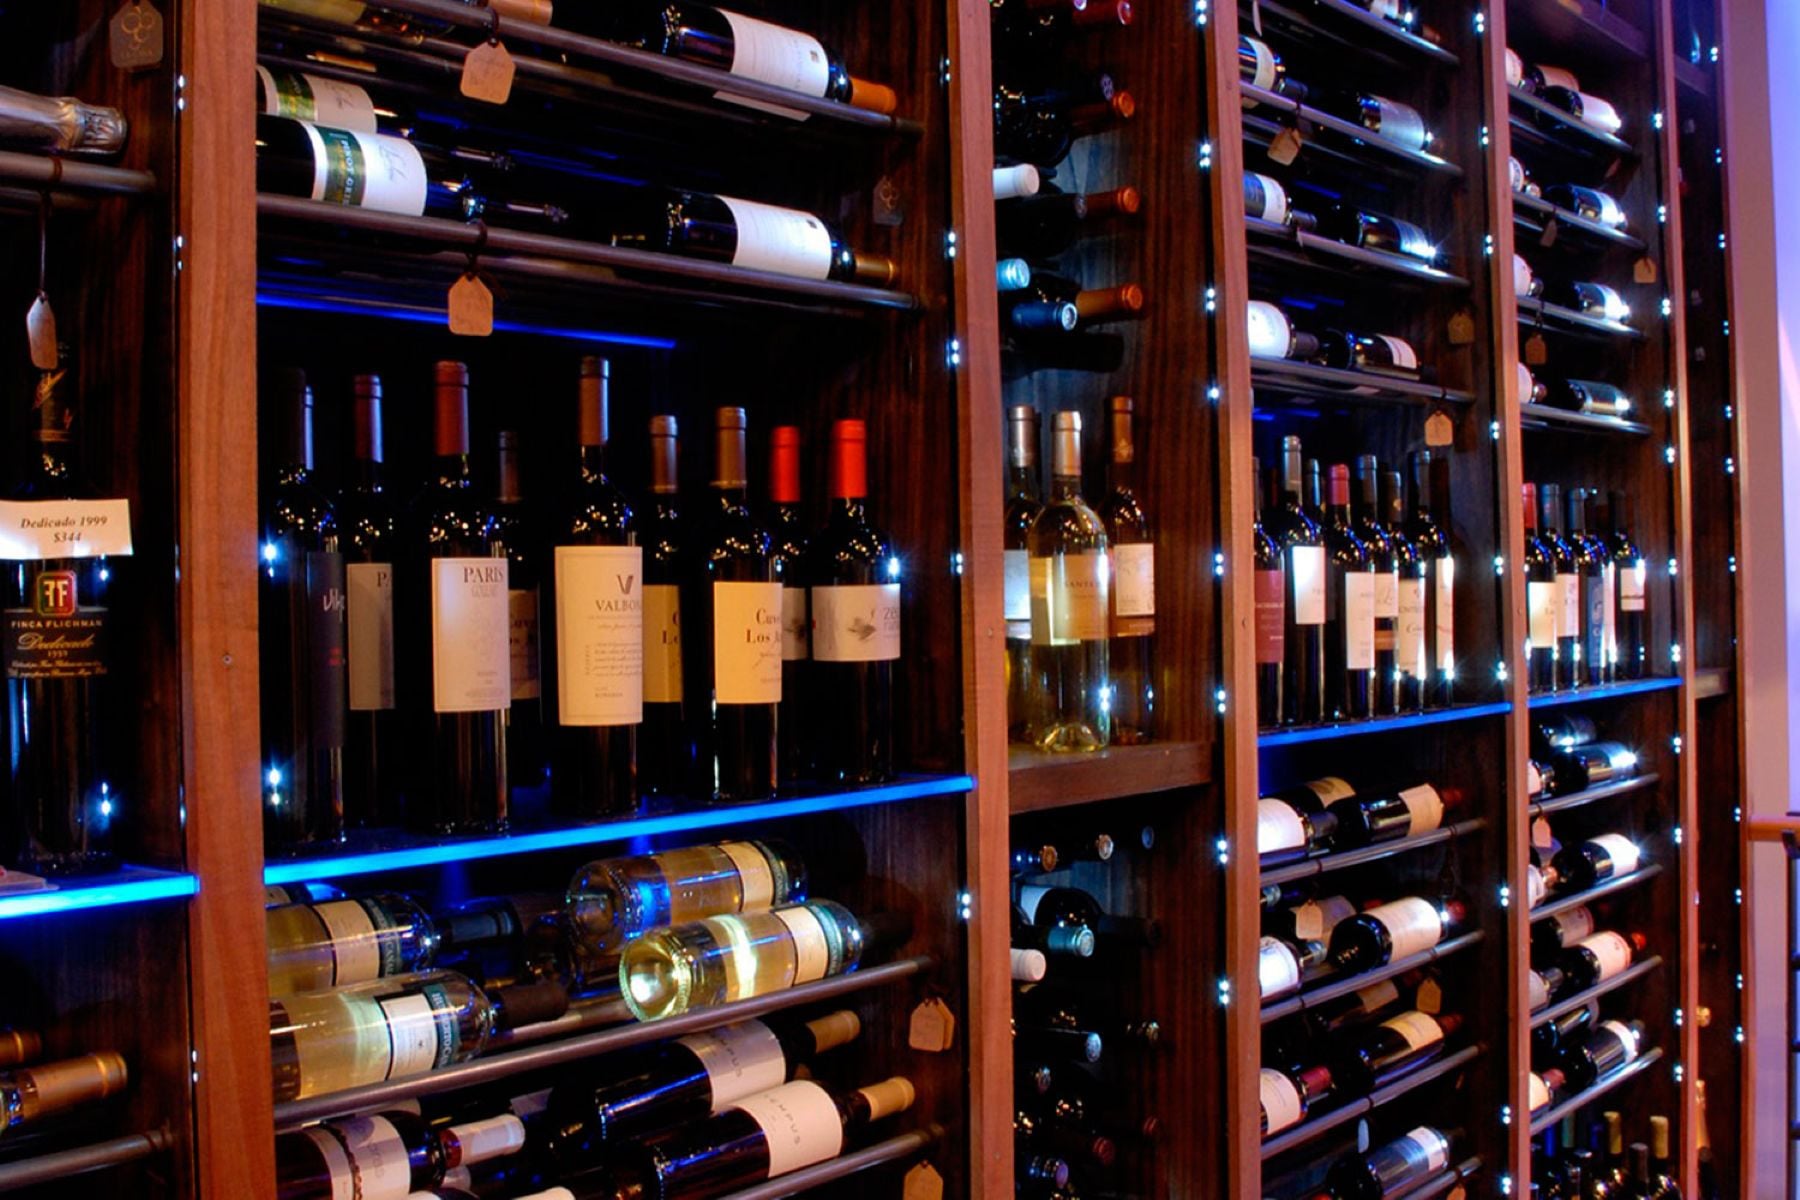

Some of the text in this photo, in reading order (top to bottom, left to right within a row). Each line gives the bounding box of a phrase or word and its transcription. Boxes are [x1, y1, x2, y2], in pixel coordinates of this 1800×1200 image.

[20, 515, 109, 529] Dedicado 1999
[53, 531, 82, 543] $344
[463, 566, 504, 584] PARIS
[10, 620, 44, 628] FINCA
[745, 628, 771, 644] Los
